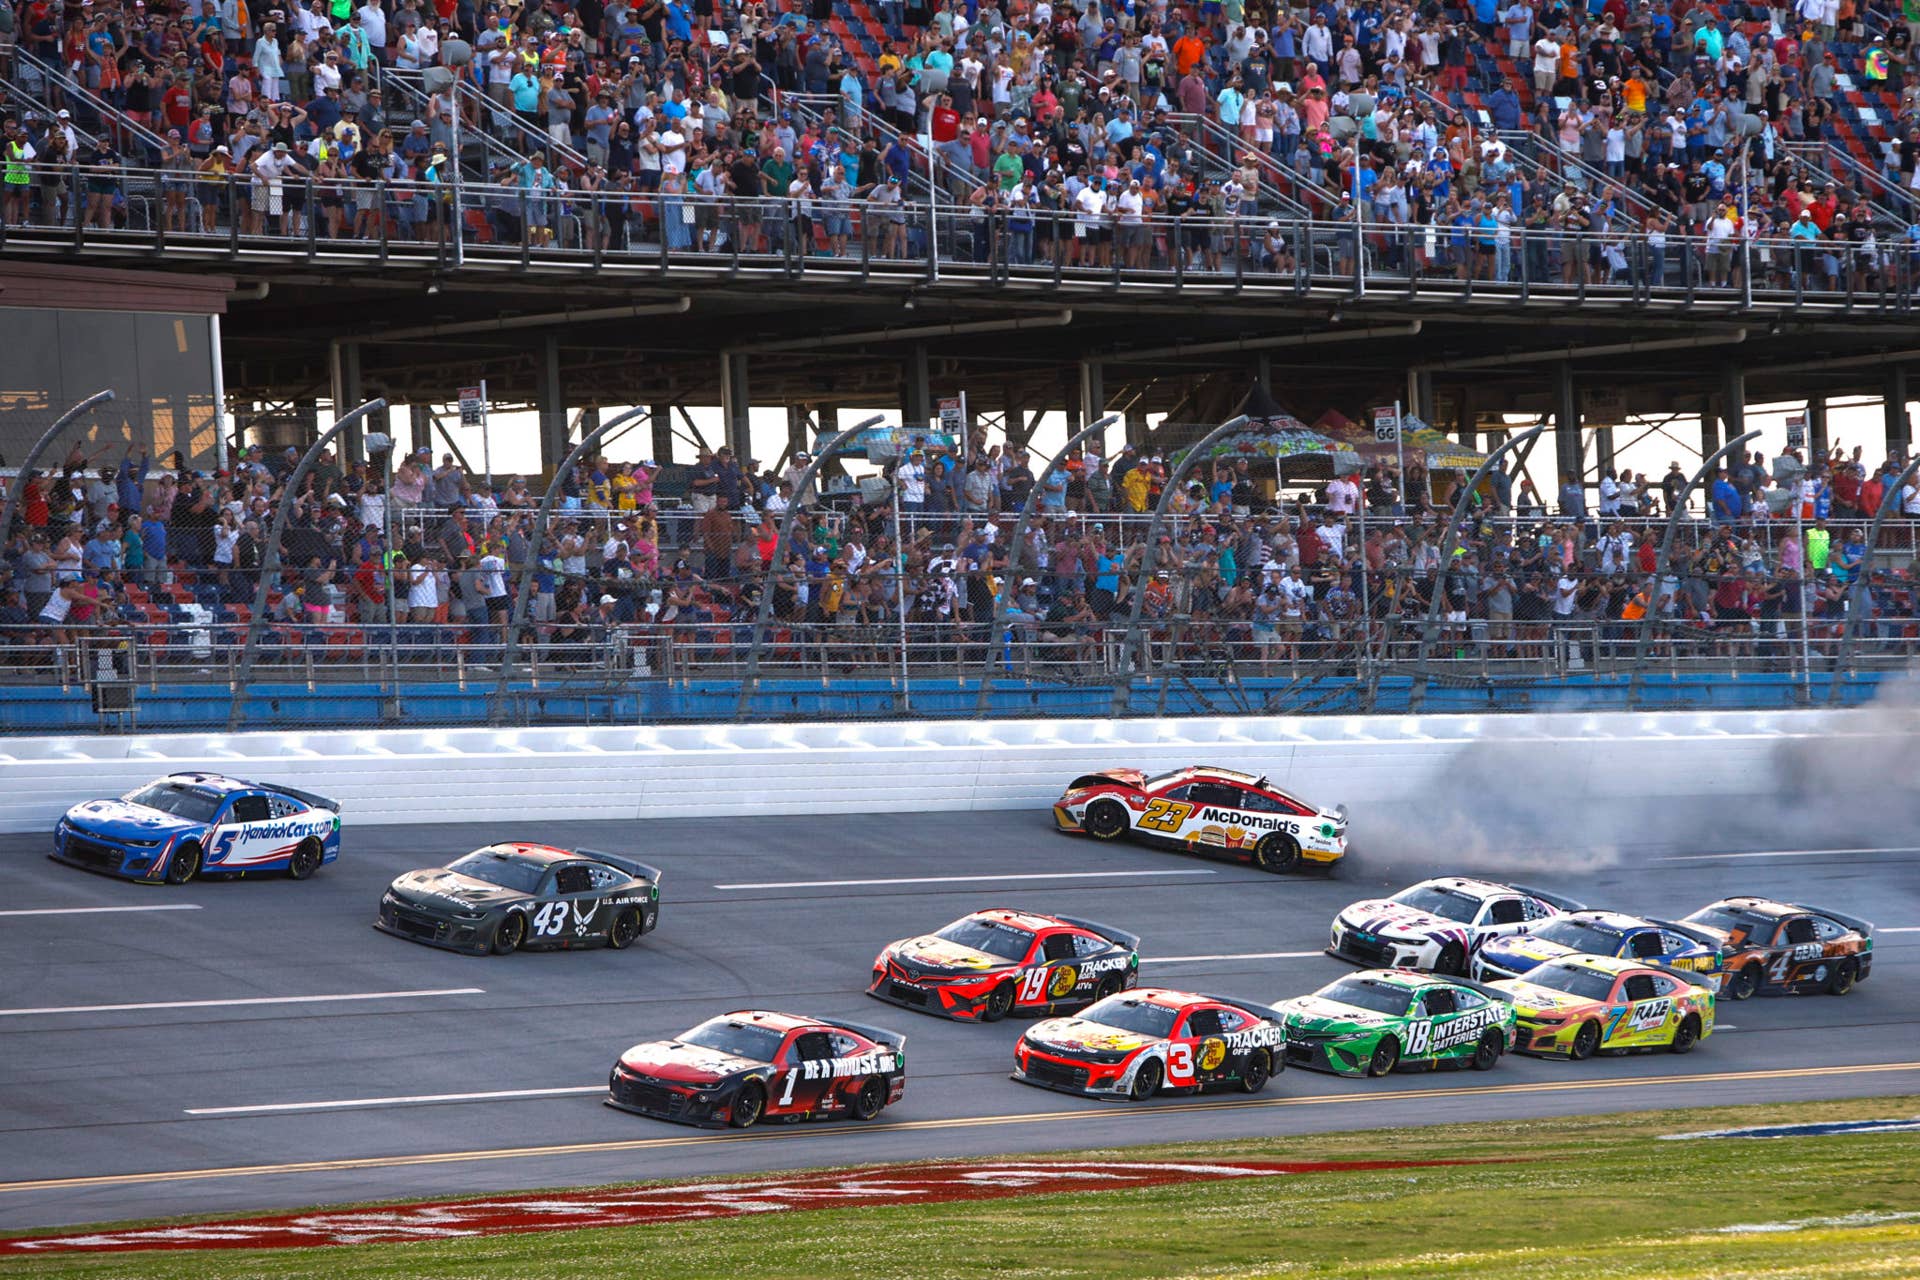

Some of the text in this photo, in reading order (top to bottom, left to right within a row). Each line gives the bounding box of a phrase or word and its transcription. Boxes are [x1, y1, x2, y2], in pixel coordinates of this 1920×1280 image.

[943, 420, 959, 432] FF
[1377, 427, 1395, 441] GG
[1136, 797, 1194, 834] 23
[1202, 807, 1301, 835] McDonald's
[240, 820, 332, 845] HendrickCars.com
[206, 830, 239, 865] 5
[615, 897, 630, 905] AIR
[629, 896, 648, 904] FORCE
[533, 902, 569, 935] 43
[1080, 957, 1127, 974] TRACKER
[1794, 943, 1824, 961] GEAR
[1770, 951, 1793, 981] 4
[1018, 967, 1048, 1001] 19
[1075, 982, 1093, 991] ATVs
[1433, 1006, 1507, 1041] INTERSTATE
[1604, 1006, 1628, 1041] 7
[1223, 1026, 1281, 1049] TRACKER
[1405, 1021, 1431, 1055] 18
[1433, 1027, 1484, 1051] BATTERIES
[1170, 1043, 1194, 1078] 3
[1232, 1047, 1252, 1056] OFF
[803, 1059, 820, 1080] BE
[820, 1058, 831, 1079] A
[830, 1053, 878, 1078] MOOSE
[779, 1067, 799, 1106] 1
